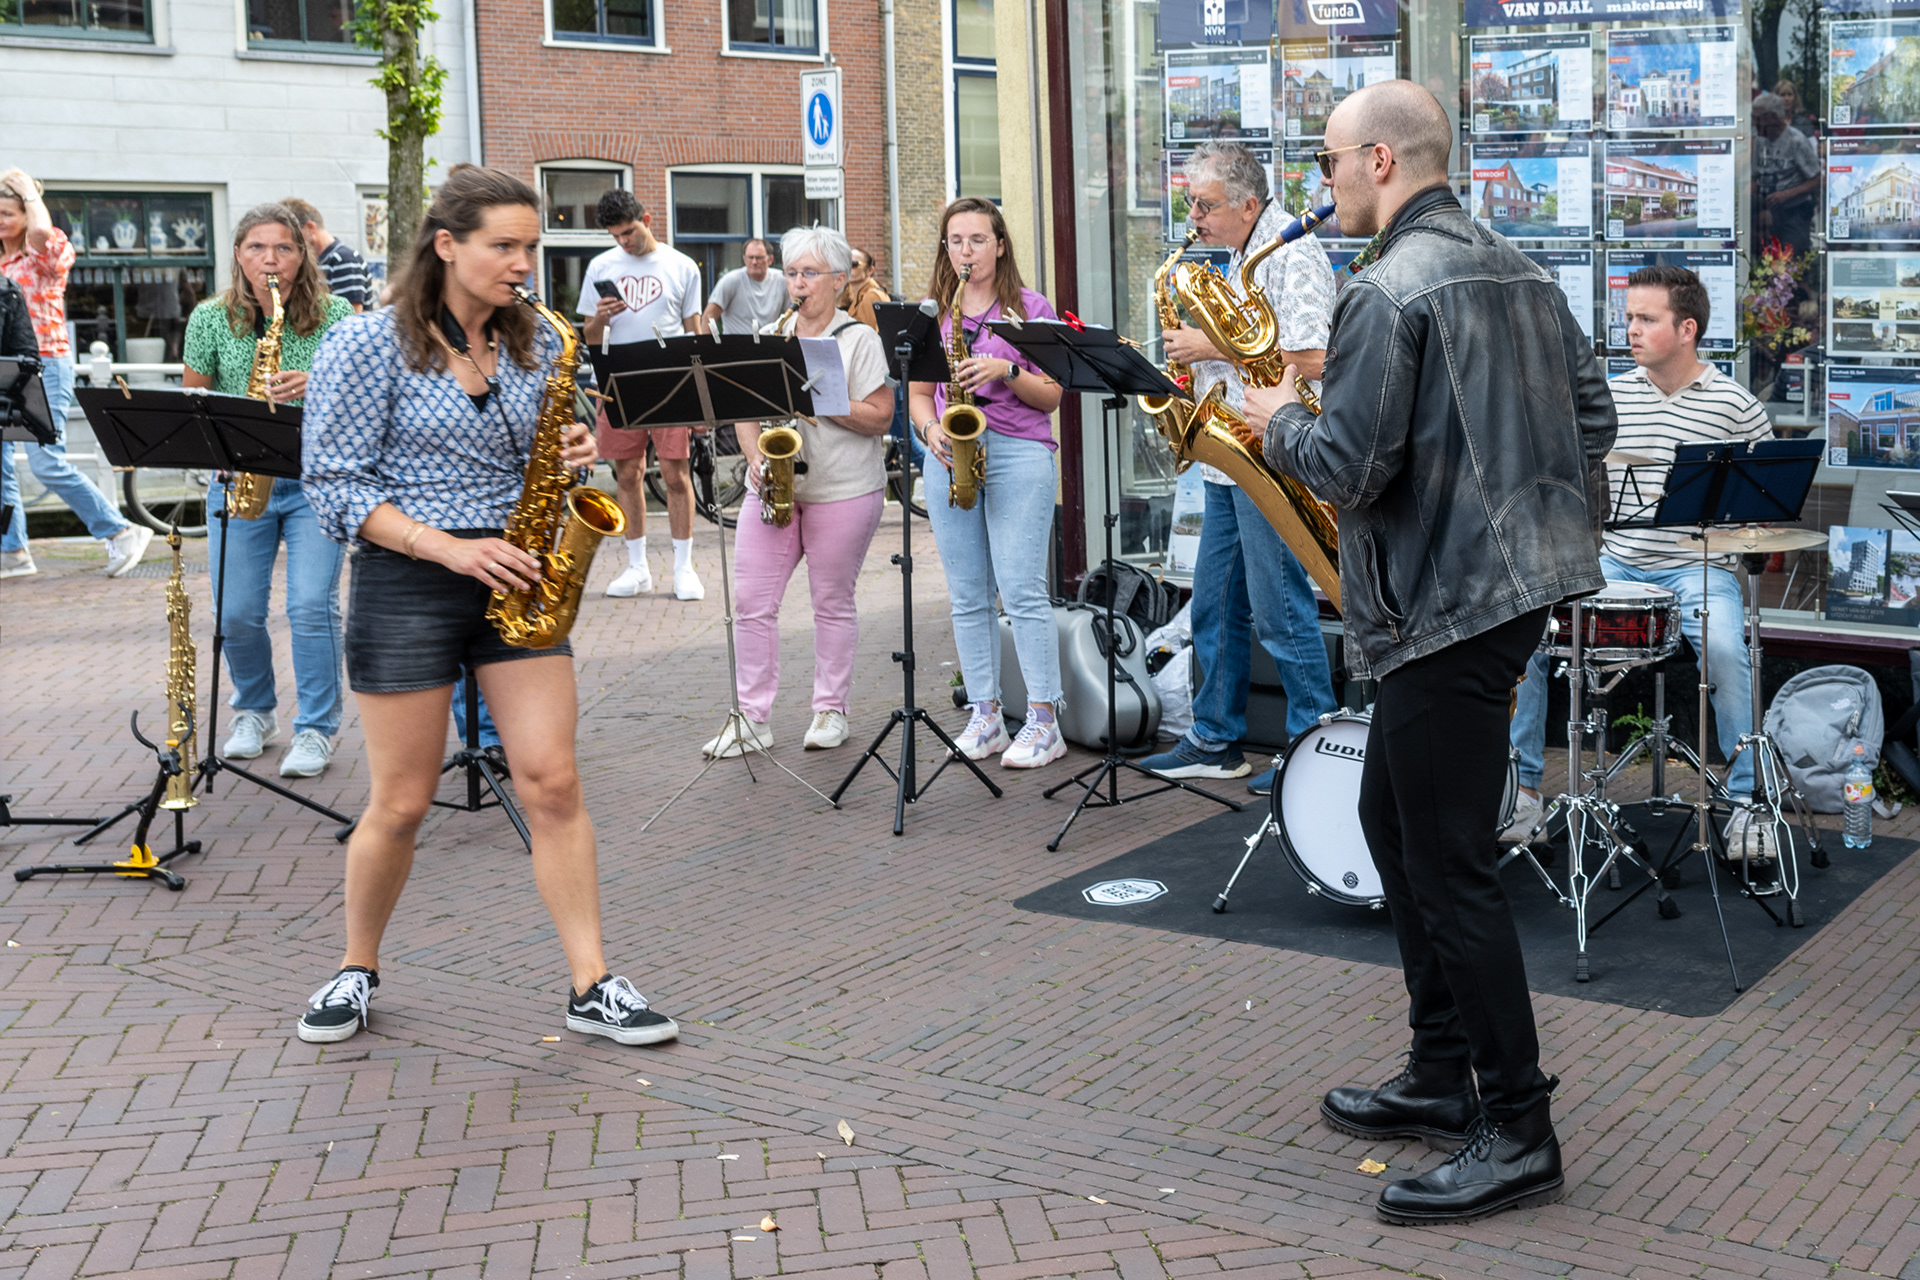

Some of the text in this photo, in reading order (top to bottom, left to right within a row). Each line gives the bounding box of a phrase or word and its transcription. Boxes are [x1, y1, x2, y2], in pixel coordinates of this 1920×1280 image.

[1318, 3, 1354, 18] funda
[1502, 0, 1704, 18] VAN DAAL makelaardij
[1204, 26, 1226, 36] NVM
[811, 76, 827, 87] ZONE
[808, 152, 834, 161] herhaling
[1474, 170, 1506, 178] VERKOCHT
